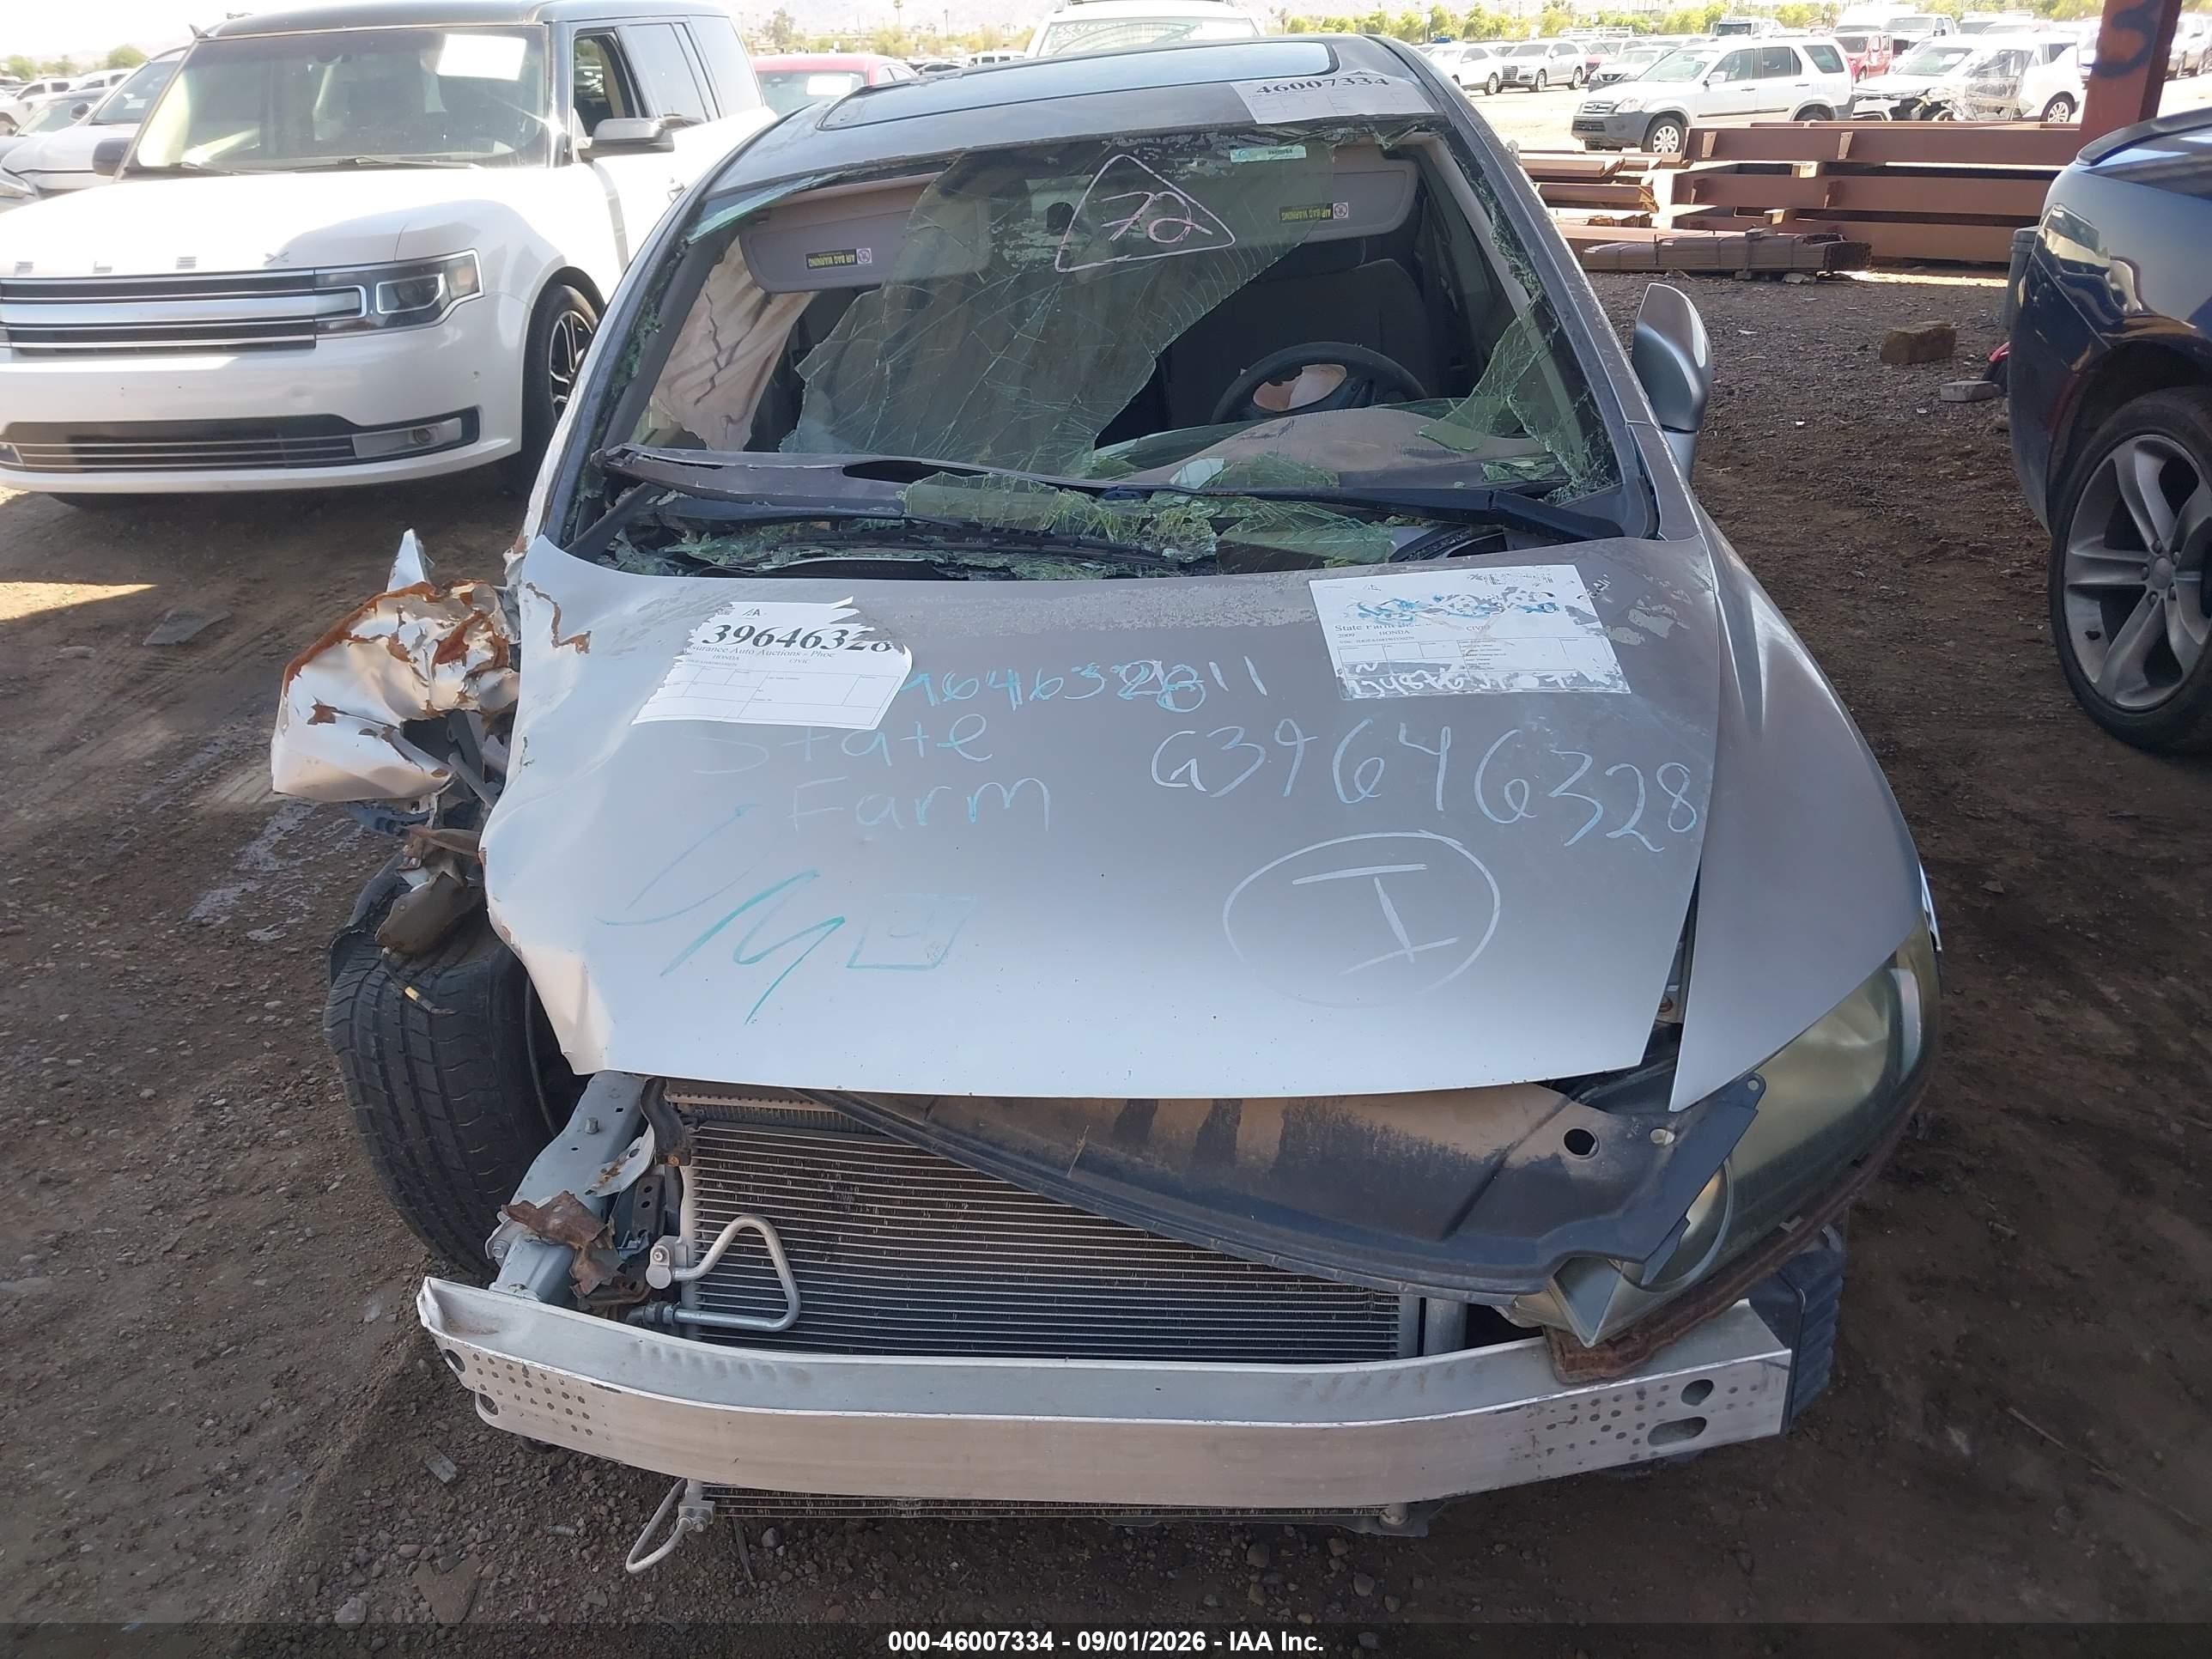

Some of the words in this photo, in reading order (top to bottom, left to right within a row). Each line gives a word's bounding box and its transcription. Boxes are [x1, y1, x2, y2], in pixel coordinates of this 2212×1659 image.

[1256, 76, 1390, 94] 46007334
[14, 251, 290, 276] FLEX
[701, 623, 893, 653] 39646328
[1334, 623, 1363, 632] State
[729, 646, 754, 655] Auto
[755, 648, 800, 658] Auctions
[683, 713, 994, 774] State
[1151, 718, 1698, 853] G39646328
[786, 776, 1052, 832] Farm
